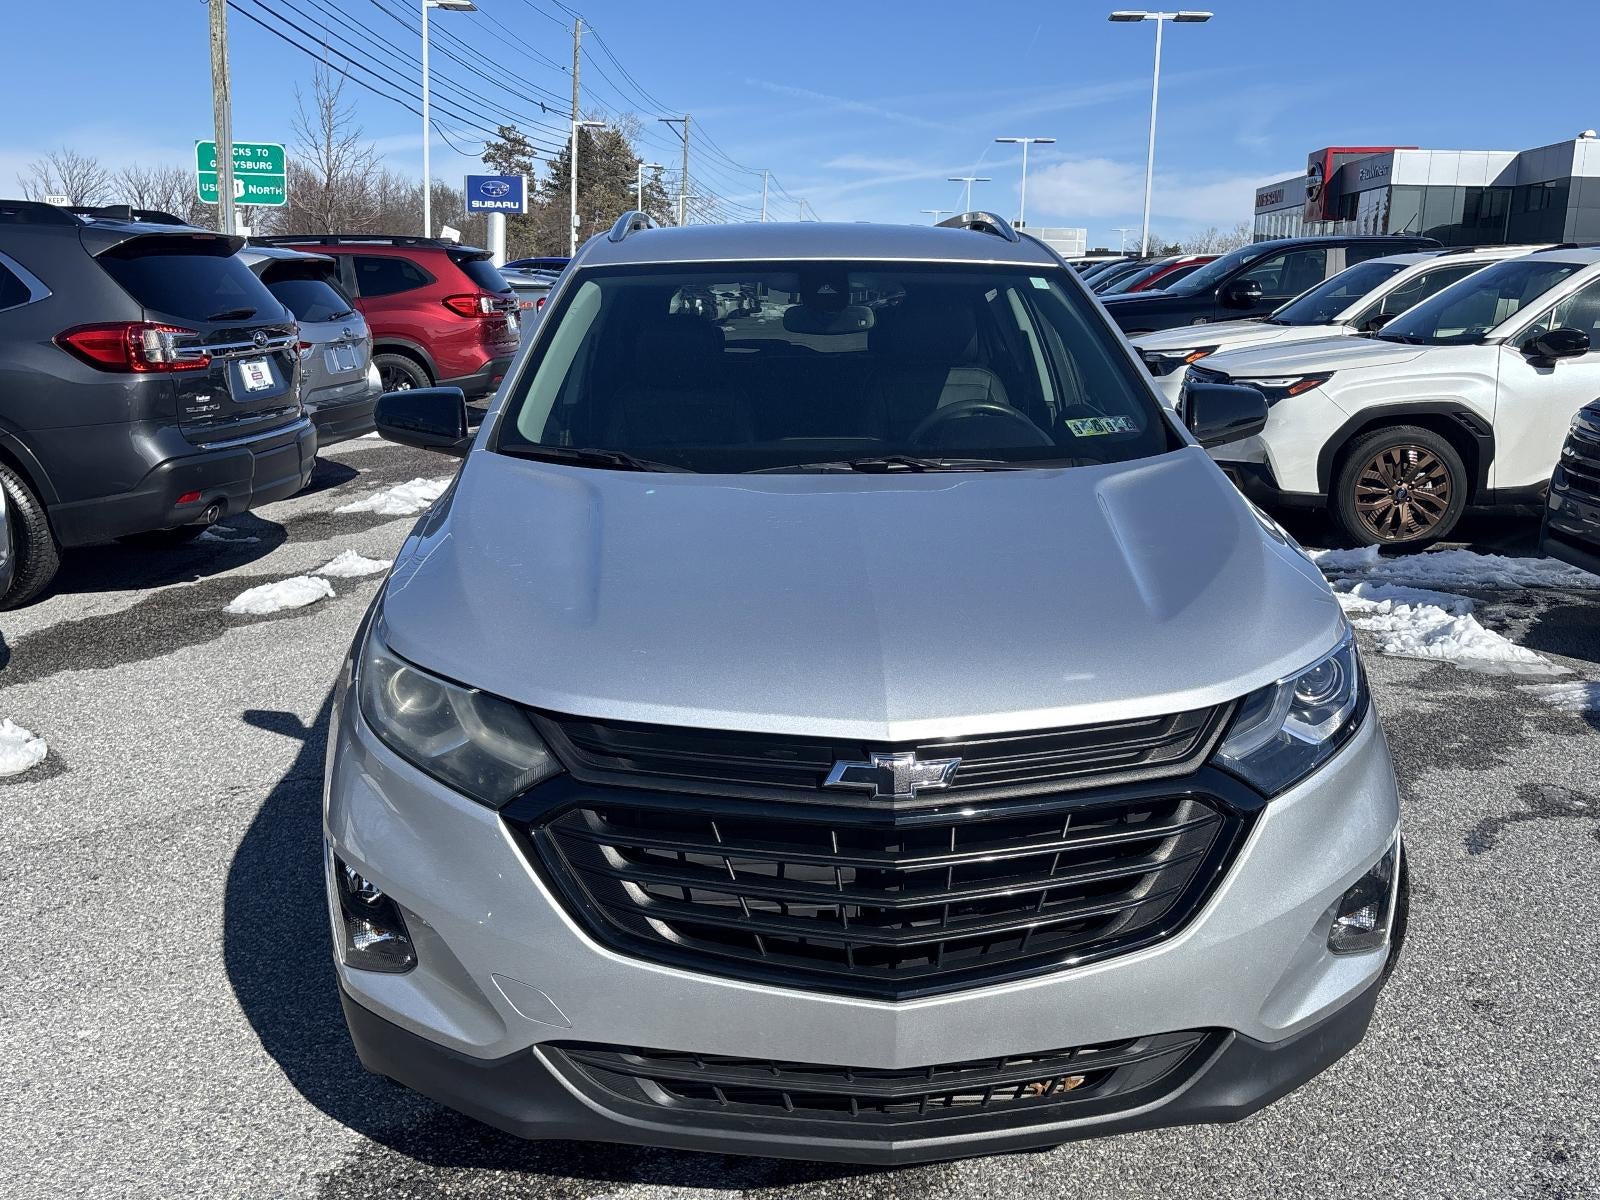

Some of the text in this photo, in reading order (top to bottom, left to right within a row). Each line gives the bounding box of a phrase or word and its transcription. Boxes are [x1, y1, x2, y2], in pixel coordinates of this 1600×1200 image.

[213, 147, 269, 157] TCKS TO
[210, 160, 273, 170] GYSBURG
[202, 183, 218, 192] US
[471, 200, 519, 209] SUBARU
